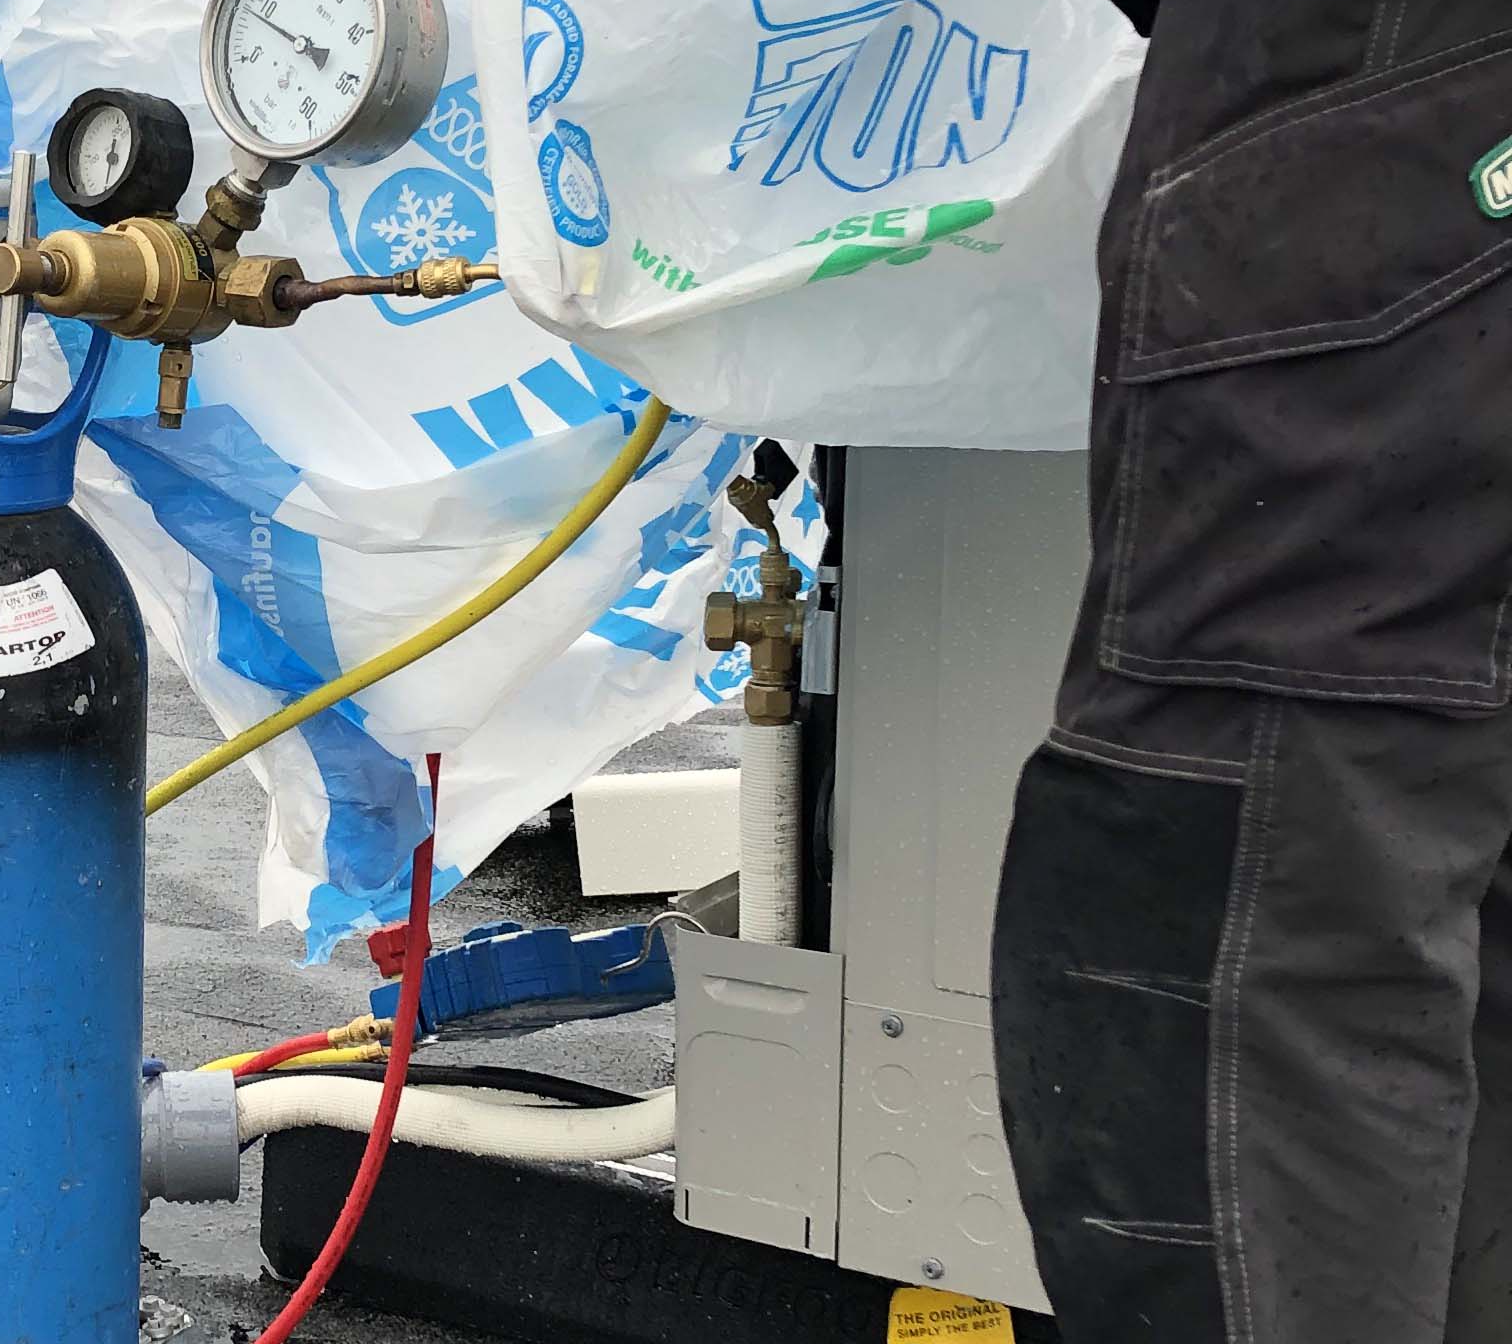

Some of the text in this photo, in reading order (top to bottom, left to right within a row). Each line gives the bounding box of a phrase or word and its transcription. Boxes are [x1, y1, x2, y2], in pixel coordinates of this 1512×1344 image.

[347, 22, 365, 45] 40
[551, 1, 580, 43] ADDED
[335, 71, 353, 96] 50
[299, 95, 318, 120] 60
[14, 604, 55, 622] ATTENTION
[896, 1303, 1002, 1325] THE ORIGINAL
[896, 1317, 1003, 1339] SIMPLY THE BEST
